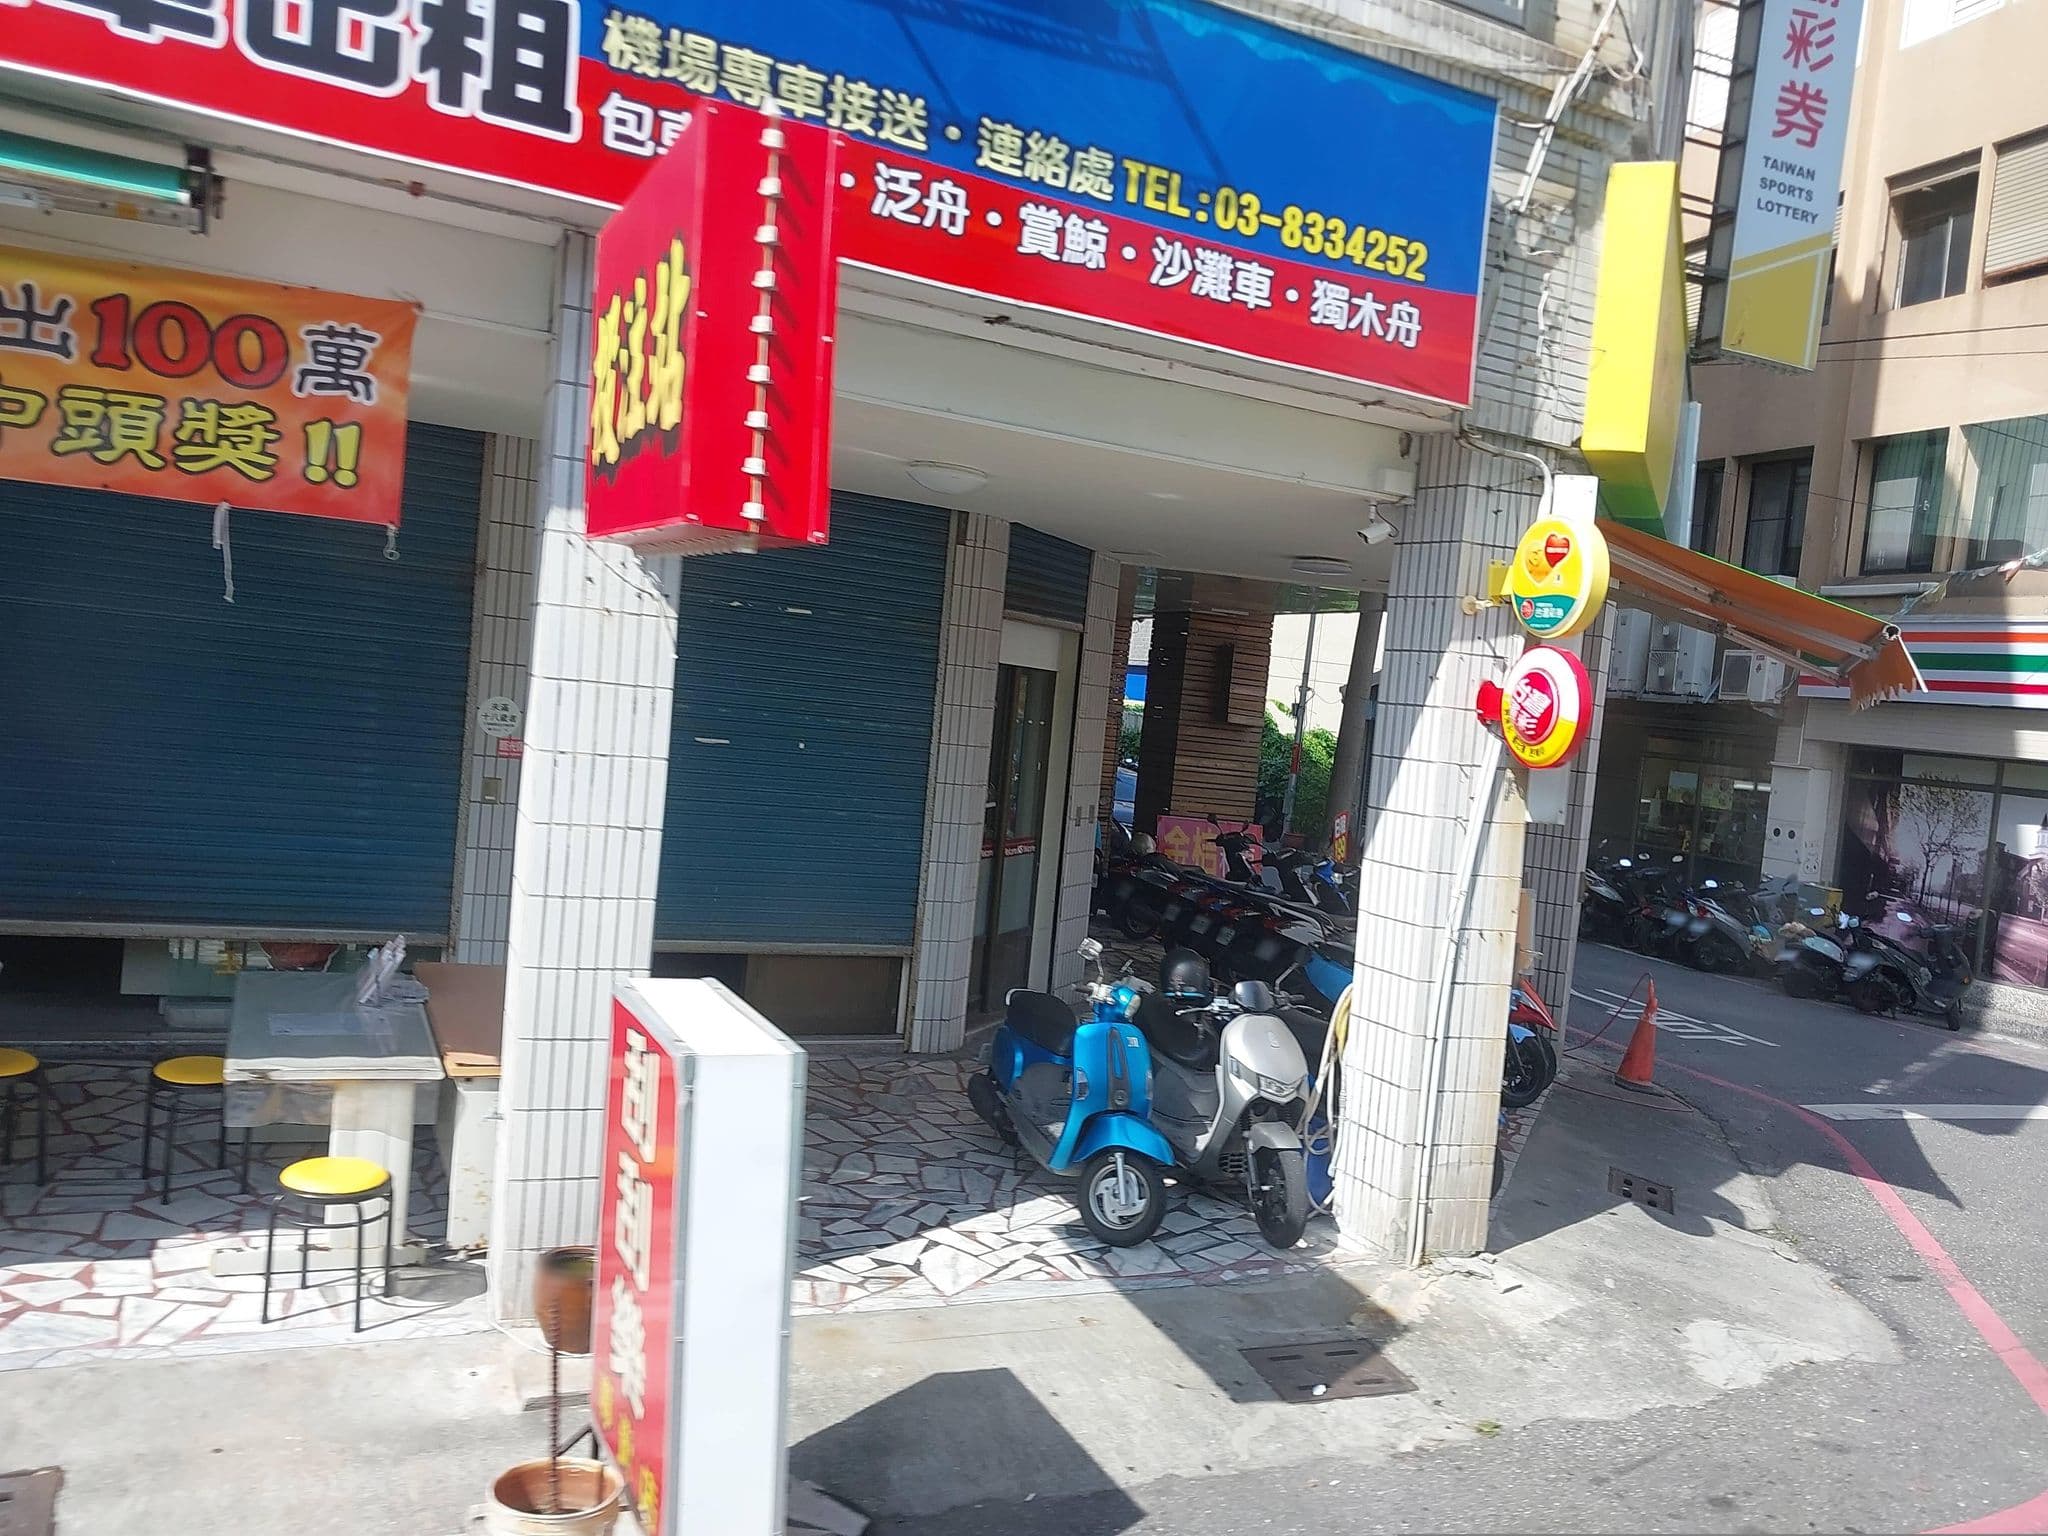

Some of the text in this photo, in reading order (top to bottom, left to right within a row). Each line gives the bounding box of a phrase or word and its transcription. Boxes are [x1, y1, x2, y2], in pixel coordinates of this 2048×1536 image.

[1772, 0, 1840, 149] 彩券
[1762, 155, 1817, 182] TAIWAN
[1759, 176, 1814, 203] SPORTS
[1121, 158, 1429, 282] TEL:03-8334252
[1756, 197, 1819, 225] LOTTERY
